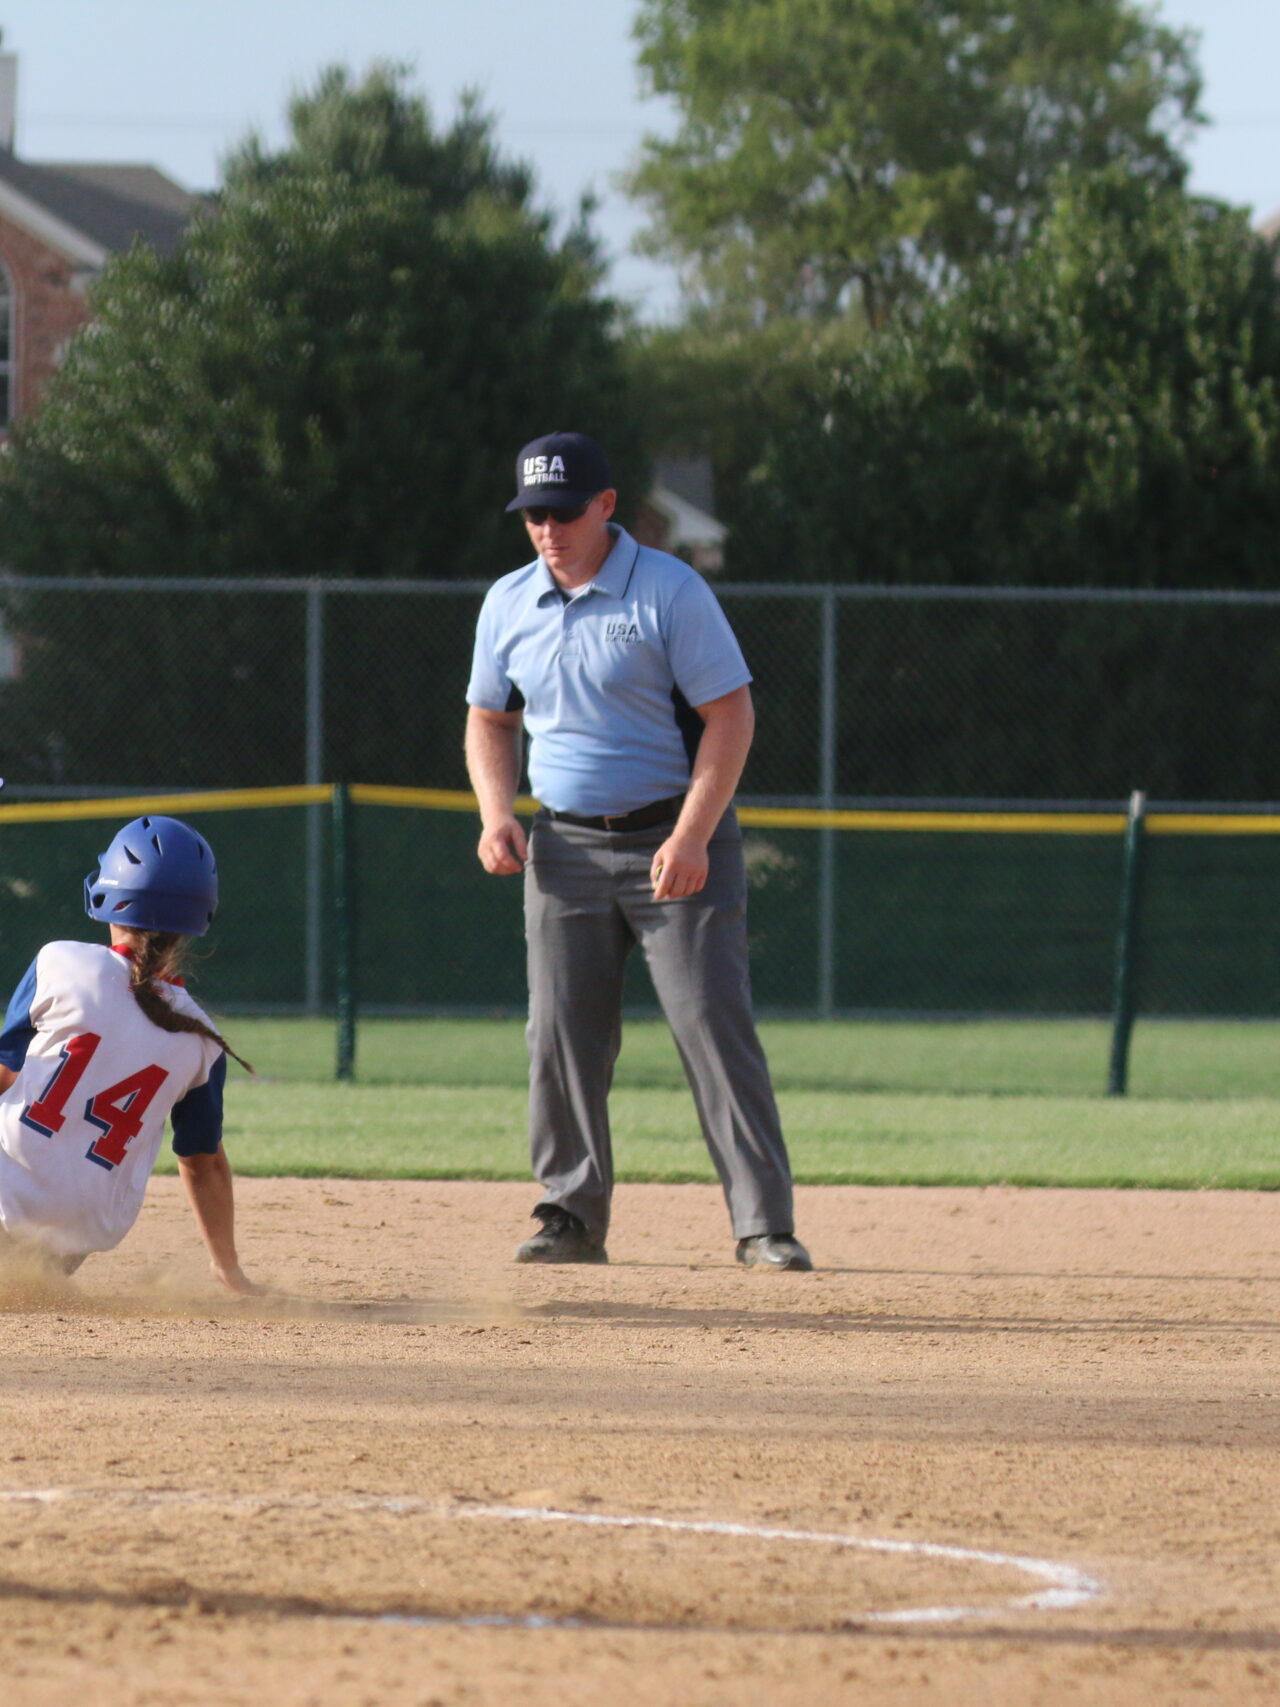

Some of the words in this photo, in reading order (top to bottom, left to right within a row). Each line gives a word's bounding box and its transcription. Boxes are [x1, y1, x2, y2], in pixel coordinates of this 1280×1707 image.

[523, 455, 565, 475] USA
[523, 472, 566, 486] SOFTBALL
[607, 623, 639, 635] USA
[19, 1032, 169, 1171] 14
